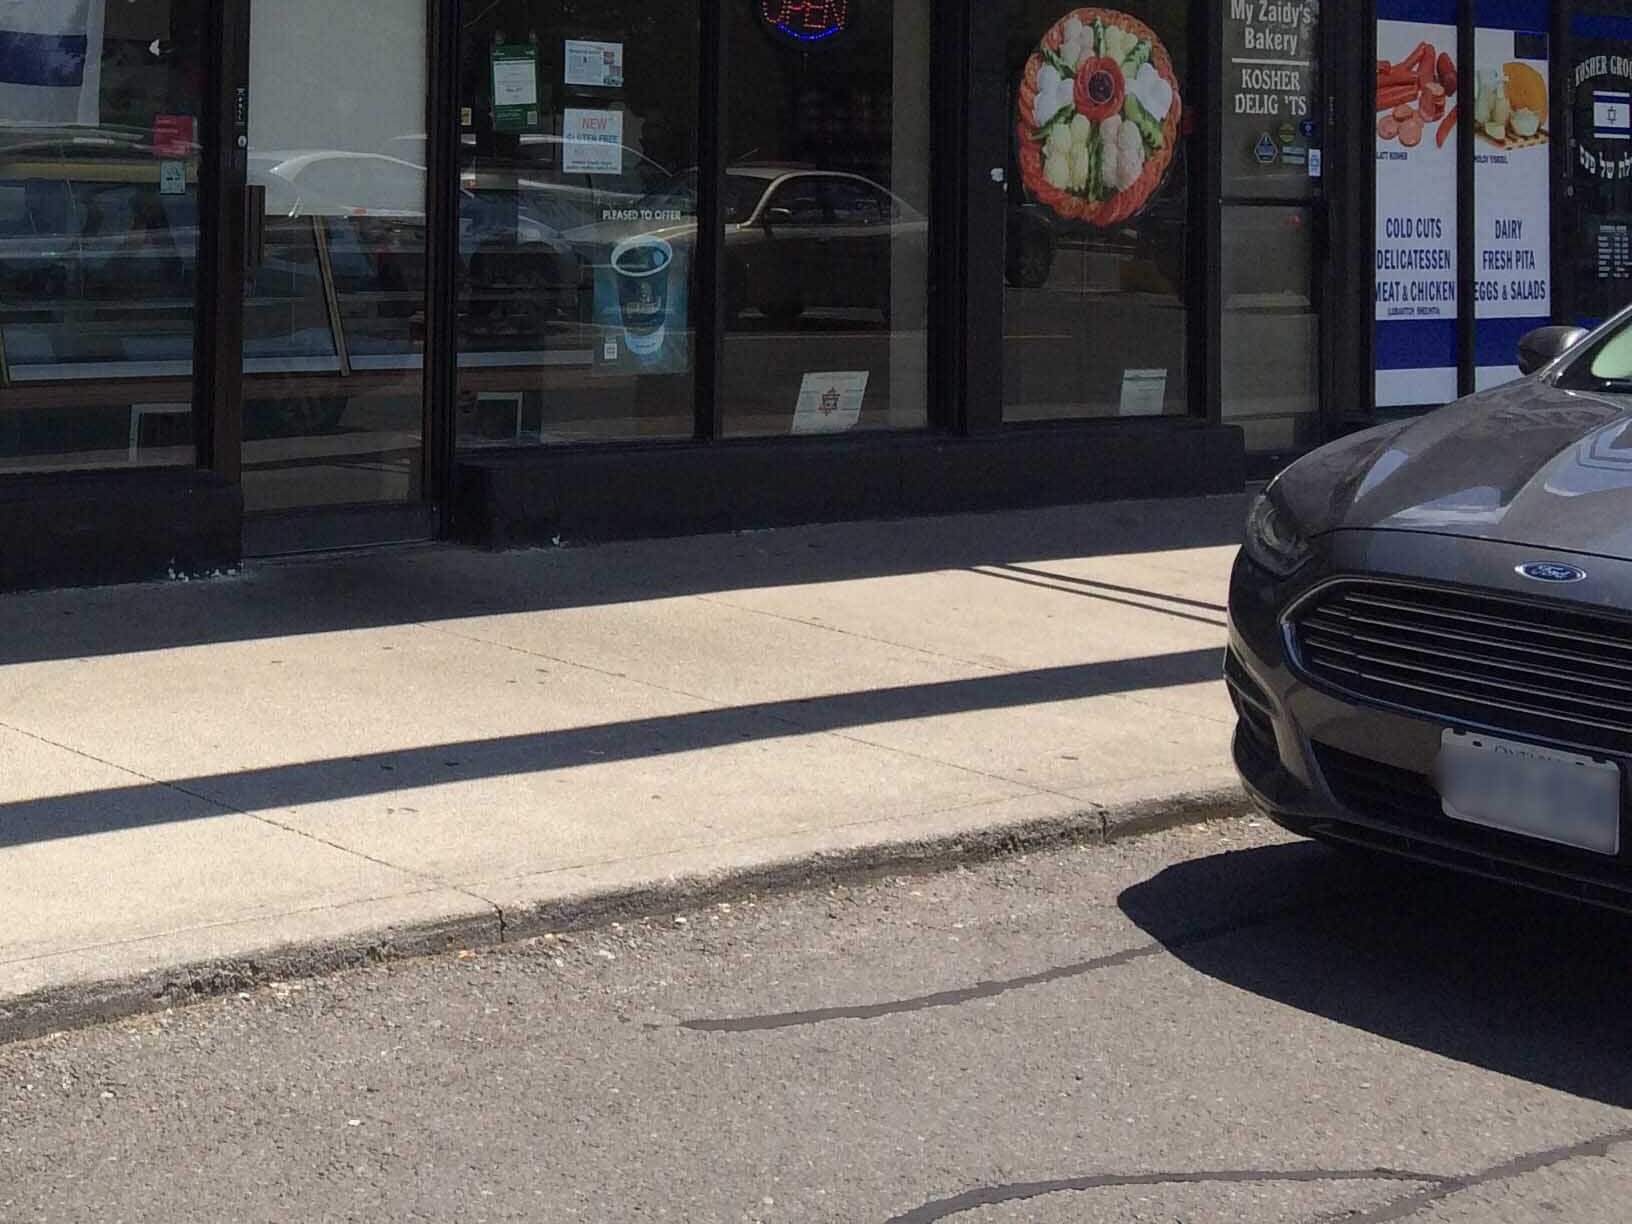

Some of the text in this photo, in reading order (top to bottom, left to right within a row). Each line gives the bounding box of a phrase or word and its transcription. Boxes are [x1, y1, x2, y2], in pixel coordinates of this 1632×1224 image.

[1258, 0, 1311, 27] Zaidy's
[1244, 27, 1298, 56] Bakery
[1610, 55, 1632, 80] GRO
[1241, 68, 1301, 91] KOSHER
[582, 118, 608, 129] NEW
[602, 209, 681, 222] PLEASED TO OFFER
[1386, 217, 1442, 239] COLD CUTS
[1495, 219, 1523, 240] DAIRY
[1377, 248, 1451, 270] DELICATESSEN
[1482, 250, 1536, 270] FRESH PITA
[1410, 279, 1456, 302] CHICKEN
[1474, 280, 1499, 301] EGGS
[1510, 279, 1546, 301] SALADS
